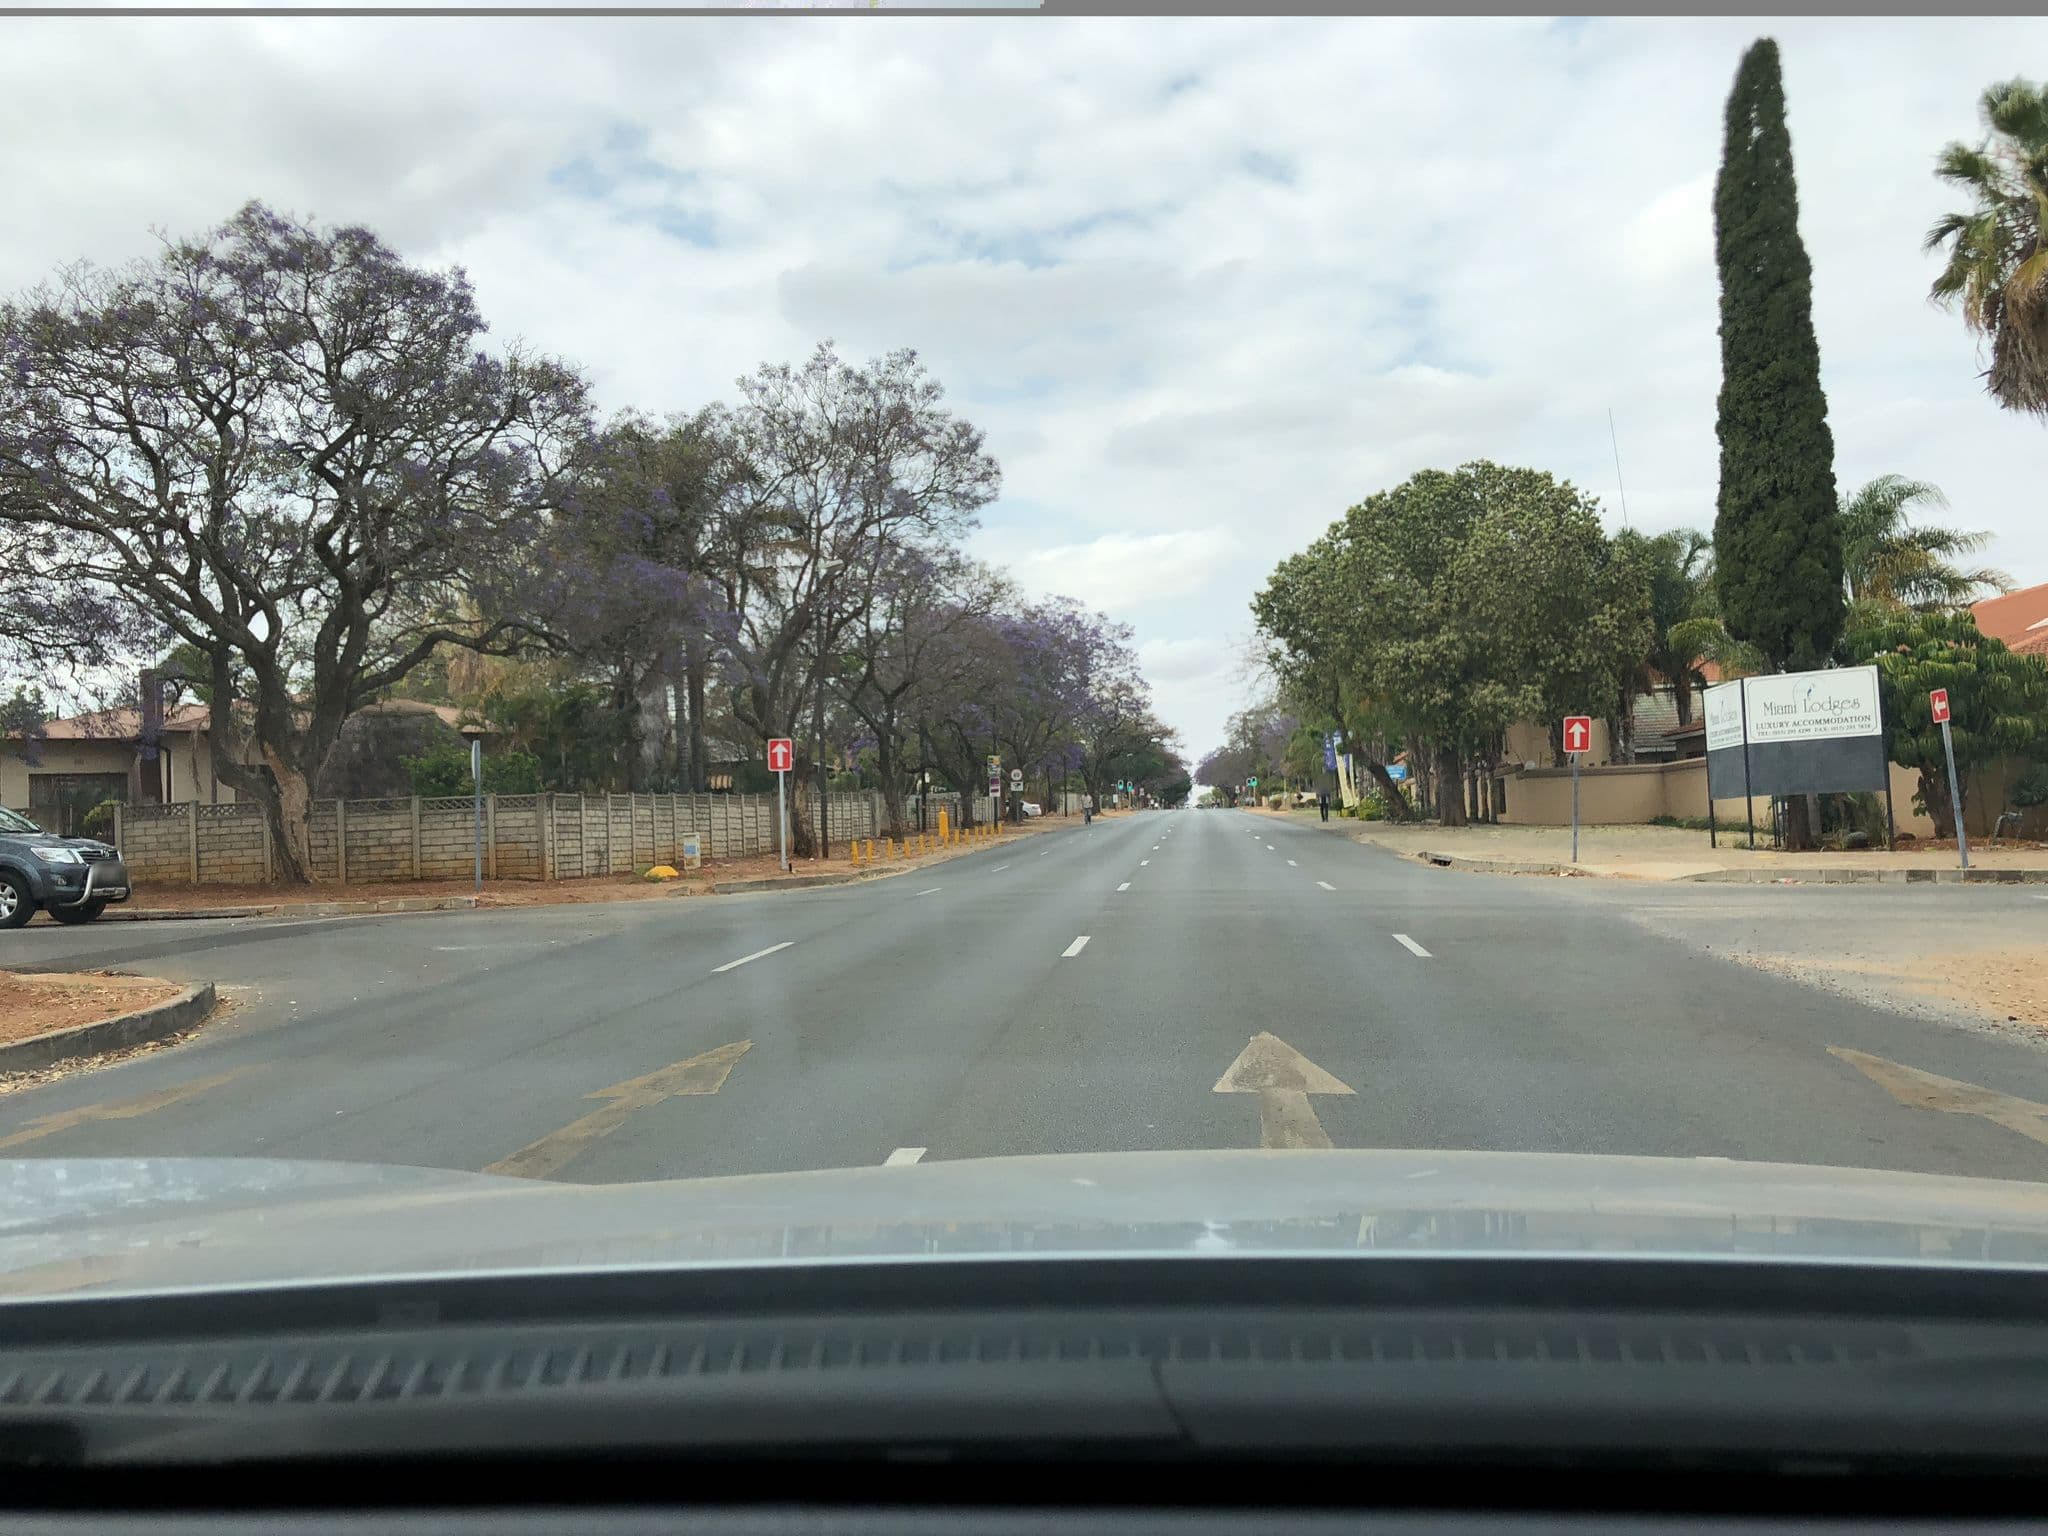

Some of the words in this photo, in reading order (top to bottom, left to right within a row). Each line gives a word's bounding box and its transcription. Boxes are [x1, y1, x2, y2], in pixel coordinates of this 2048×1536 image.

[1763, 702, 1797, 716] Miami
[1803, 696, 1860, 716] Lodges
[1756, 721, 1790, 730] LUXURY
[1792, 715, 1871, 727] ACCOMMODATION
